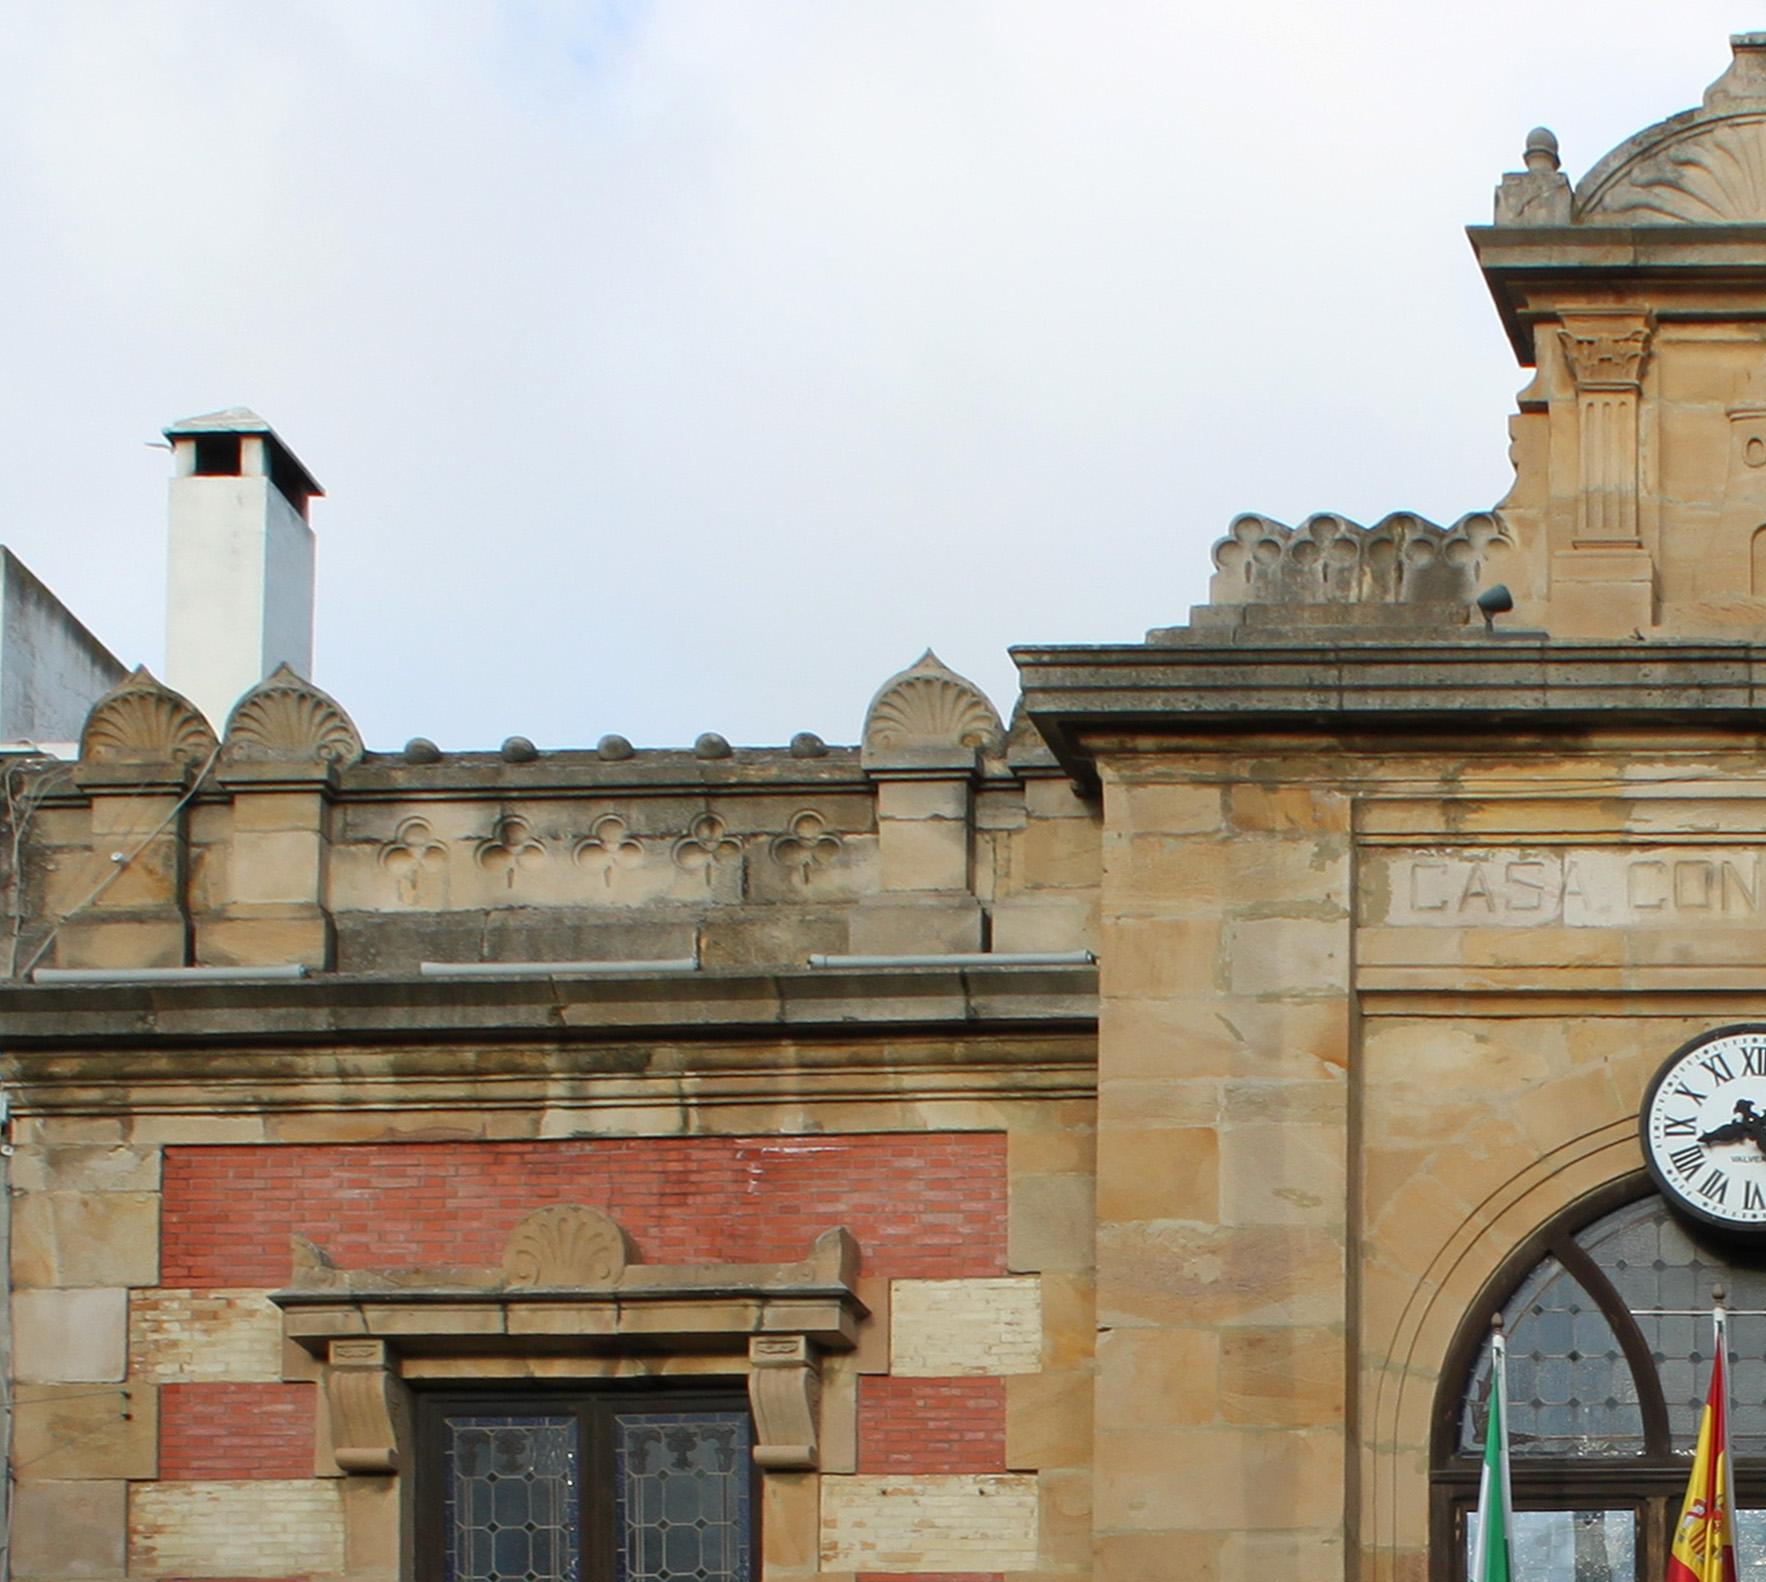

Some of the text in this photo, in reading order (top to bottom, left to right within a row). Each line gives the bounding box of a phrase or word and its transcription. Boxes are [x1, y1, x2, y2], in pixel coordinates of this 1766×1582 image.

[1409, 860, 1590, 913] CASA
[1700, 1053, 1735, 1087] XI
[1673, 1081, 1708, 1107] X
[1664, 1115, 1697, 1137] IX
[1670, 1144, 1704, 1182] VIII
[1700, 1168, 1730, 1205] VII
[1742, 1180, 1766, 1211] VI
